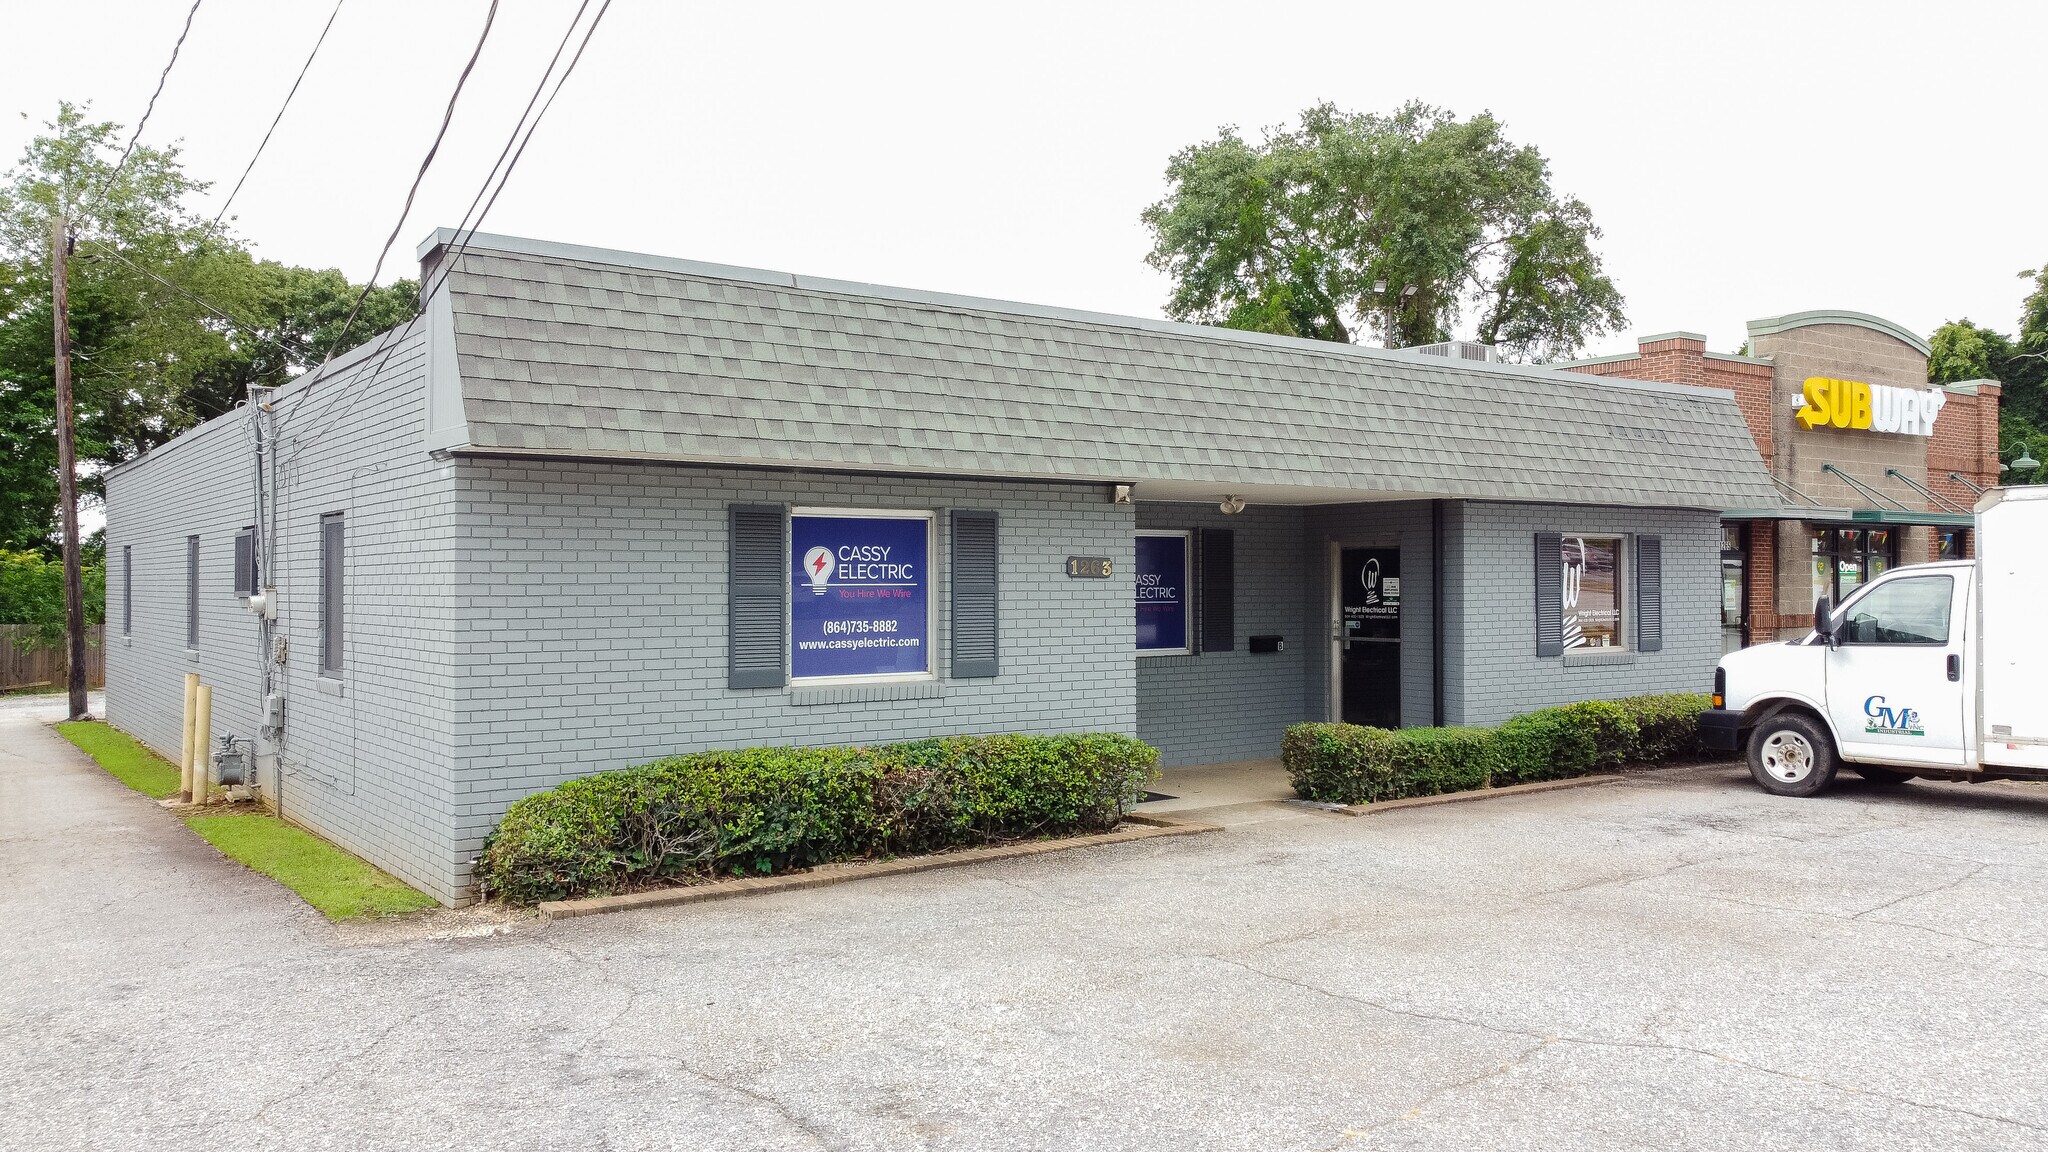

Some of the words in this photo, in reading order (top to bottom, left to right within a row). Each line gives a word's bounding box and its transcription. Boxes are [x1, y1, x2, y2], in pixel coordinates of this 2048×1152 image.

[1796, 377, 1947, 437] SUBWAY
[838, 545, 891, 562] CASSY
[838, 563, 913, 580] ELECTRIC
[1070, 559, 1112, 576] 1263
[1839, 560, 1858, 573] Open
[1135, 574, 1161, 586] ASSY
[839, 589, 855, 599] You
[857, 589, 875, 598] Hire
[877, 589, 891, 598] We
[893, 589, 912, 598] Wire
[1135, 587, 1176, 599] LECTRIC
[1344, 606, 1361, 615] Wright
[1362, 606, 1387, 614] Electrical
[1388, 606, 1398, 614] LLC
[823, 620, 898, 636] (864)735-8882
[799, 637, 920, 651] www.cassyelectric.com
